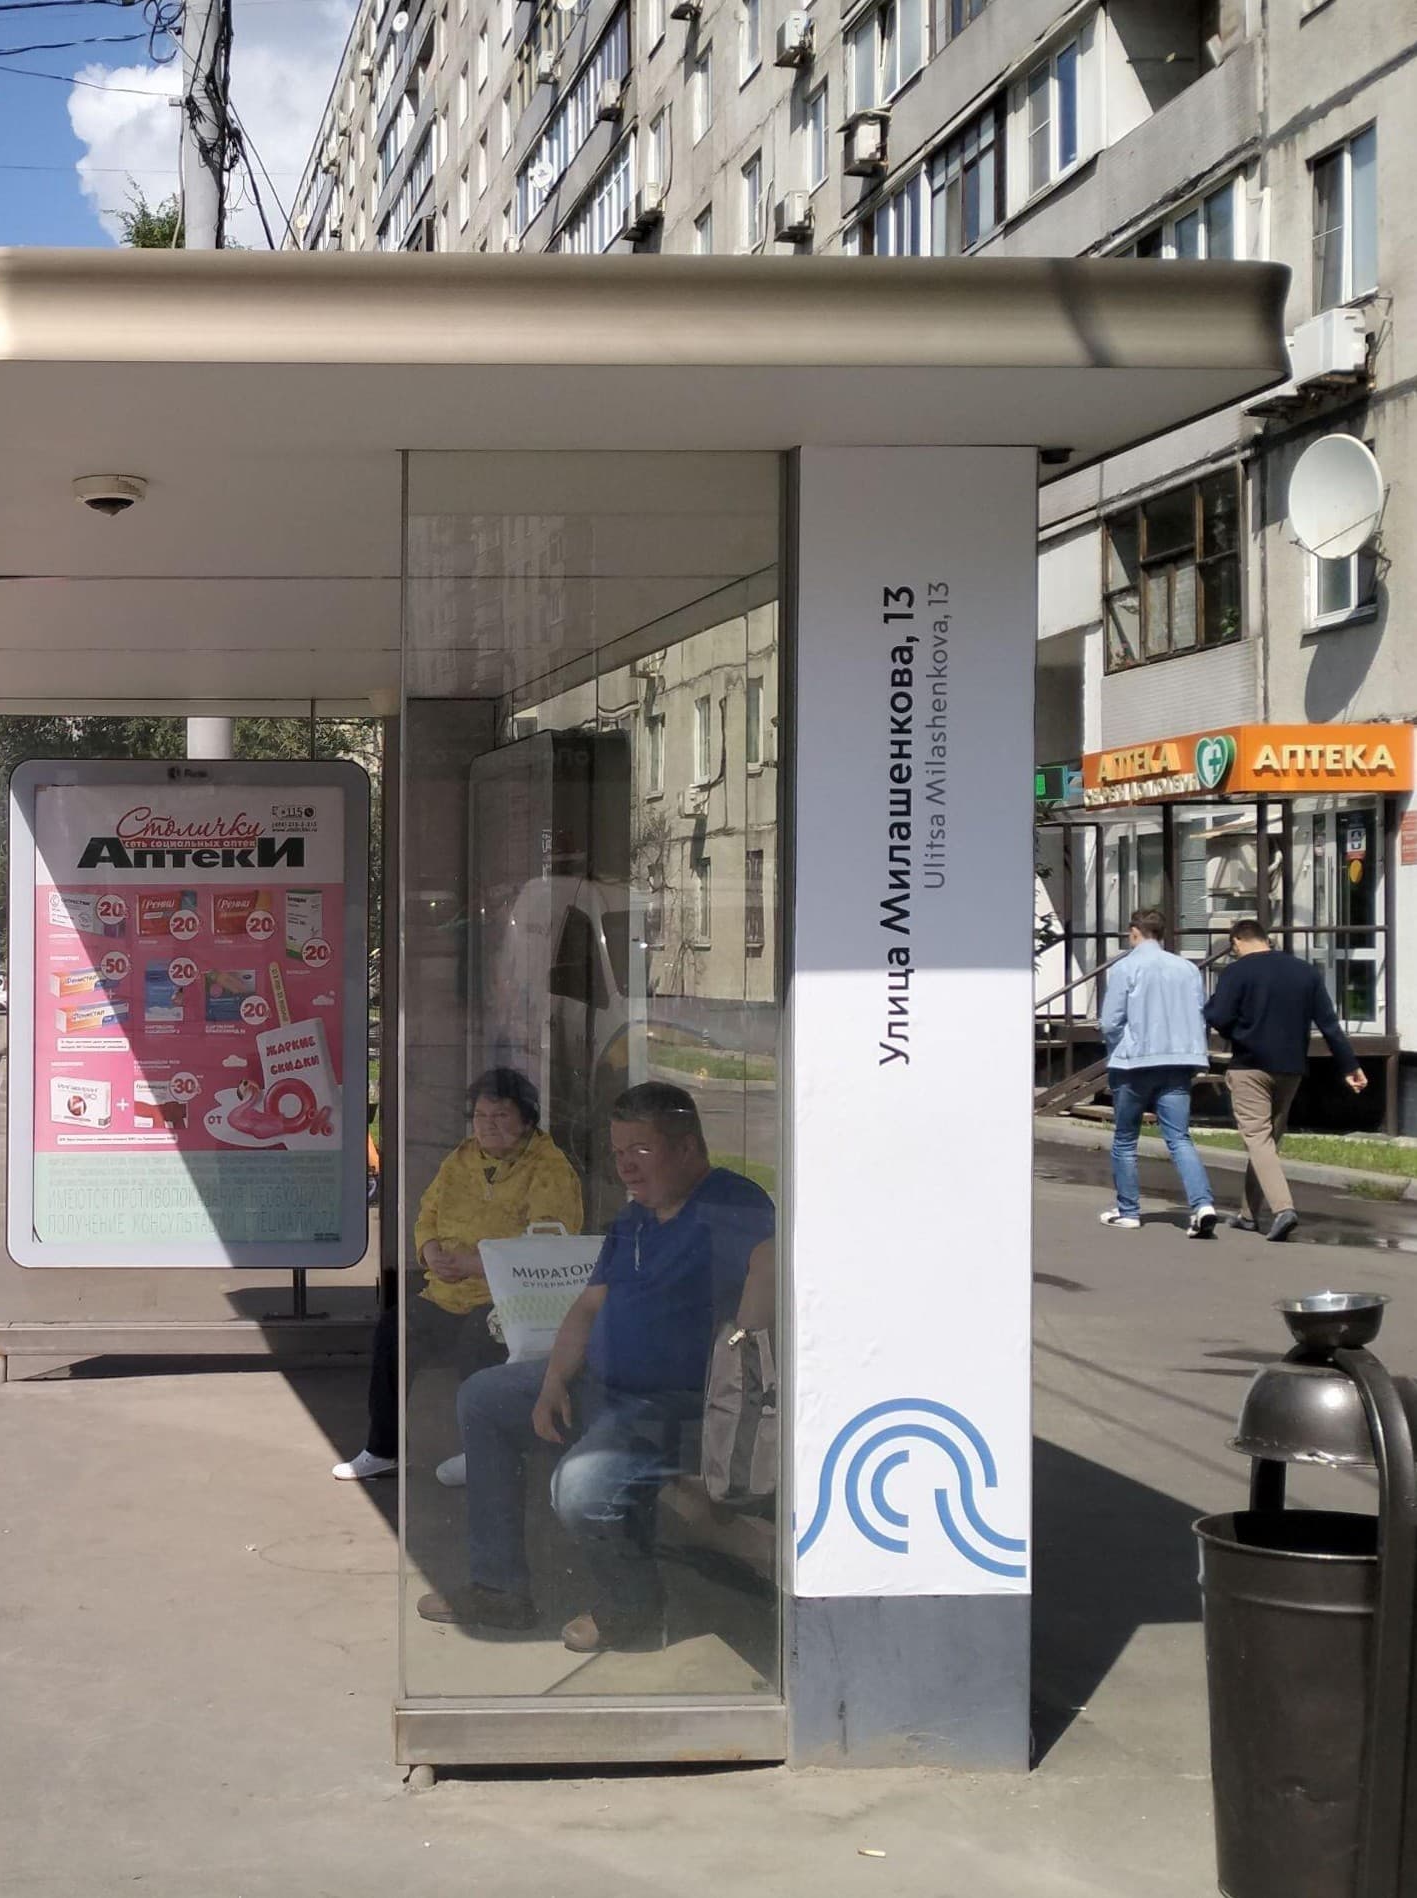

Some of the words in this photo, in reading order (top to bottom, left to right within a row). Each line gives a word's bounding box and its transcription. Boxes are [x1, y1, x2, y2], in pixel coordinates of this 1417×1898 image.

[883, 585, 914, 624] 13
[927, 581, 949, 607] 13
[925, 613, 952, 806] Milashenkova,
[1097, 743, 1181, 782] АПТЕКА
[1253, 744, 1396, 777] АПТЕКА
[880, 634, 920, 935] Милашенкова,
[116, 807, 266, 839] Столички
[150, 839, 220, 849] социальных
[924, 812, 946, 889] Ulitsa
[879, 945, 914, 1066] Улица
[266, 1036, 316, 1057] ЖАРКИЕ
[270, 1055, 320, 1075] СКИДКИ
[512, 1262, 594, 1279] МИРАТОР
[523, 1279, 587, 1288] СУПЕРМАРК
